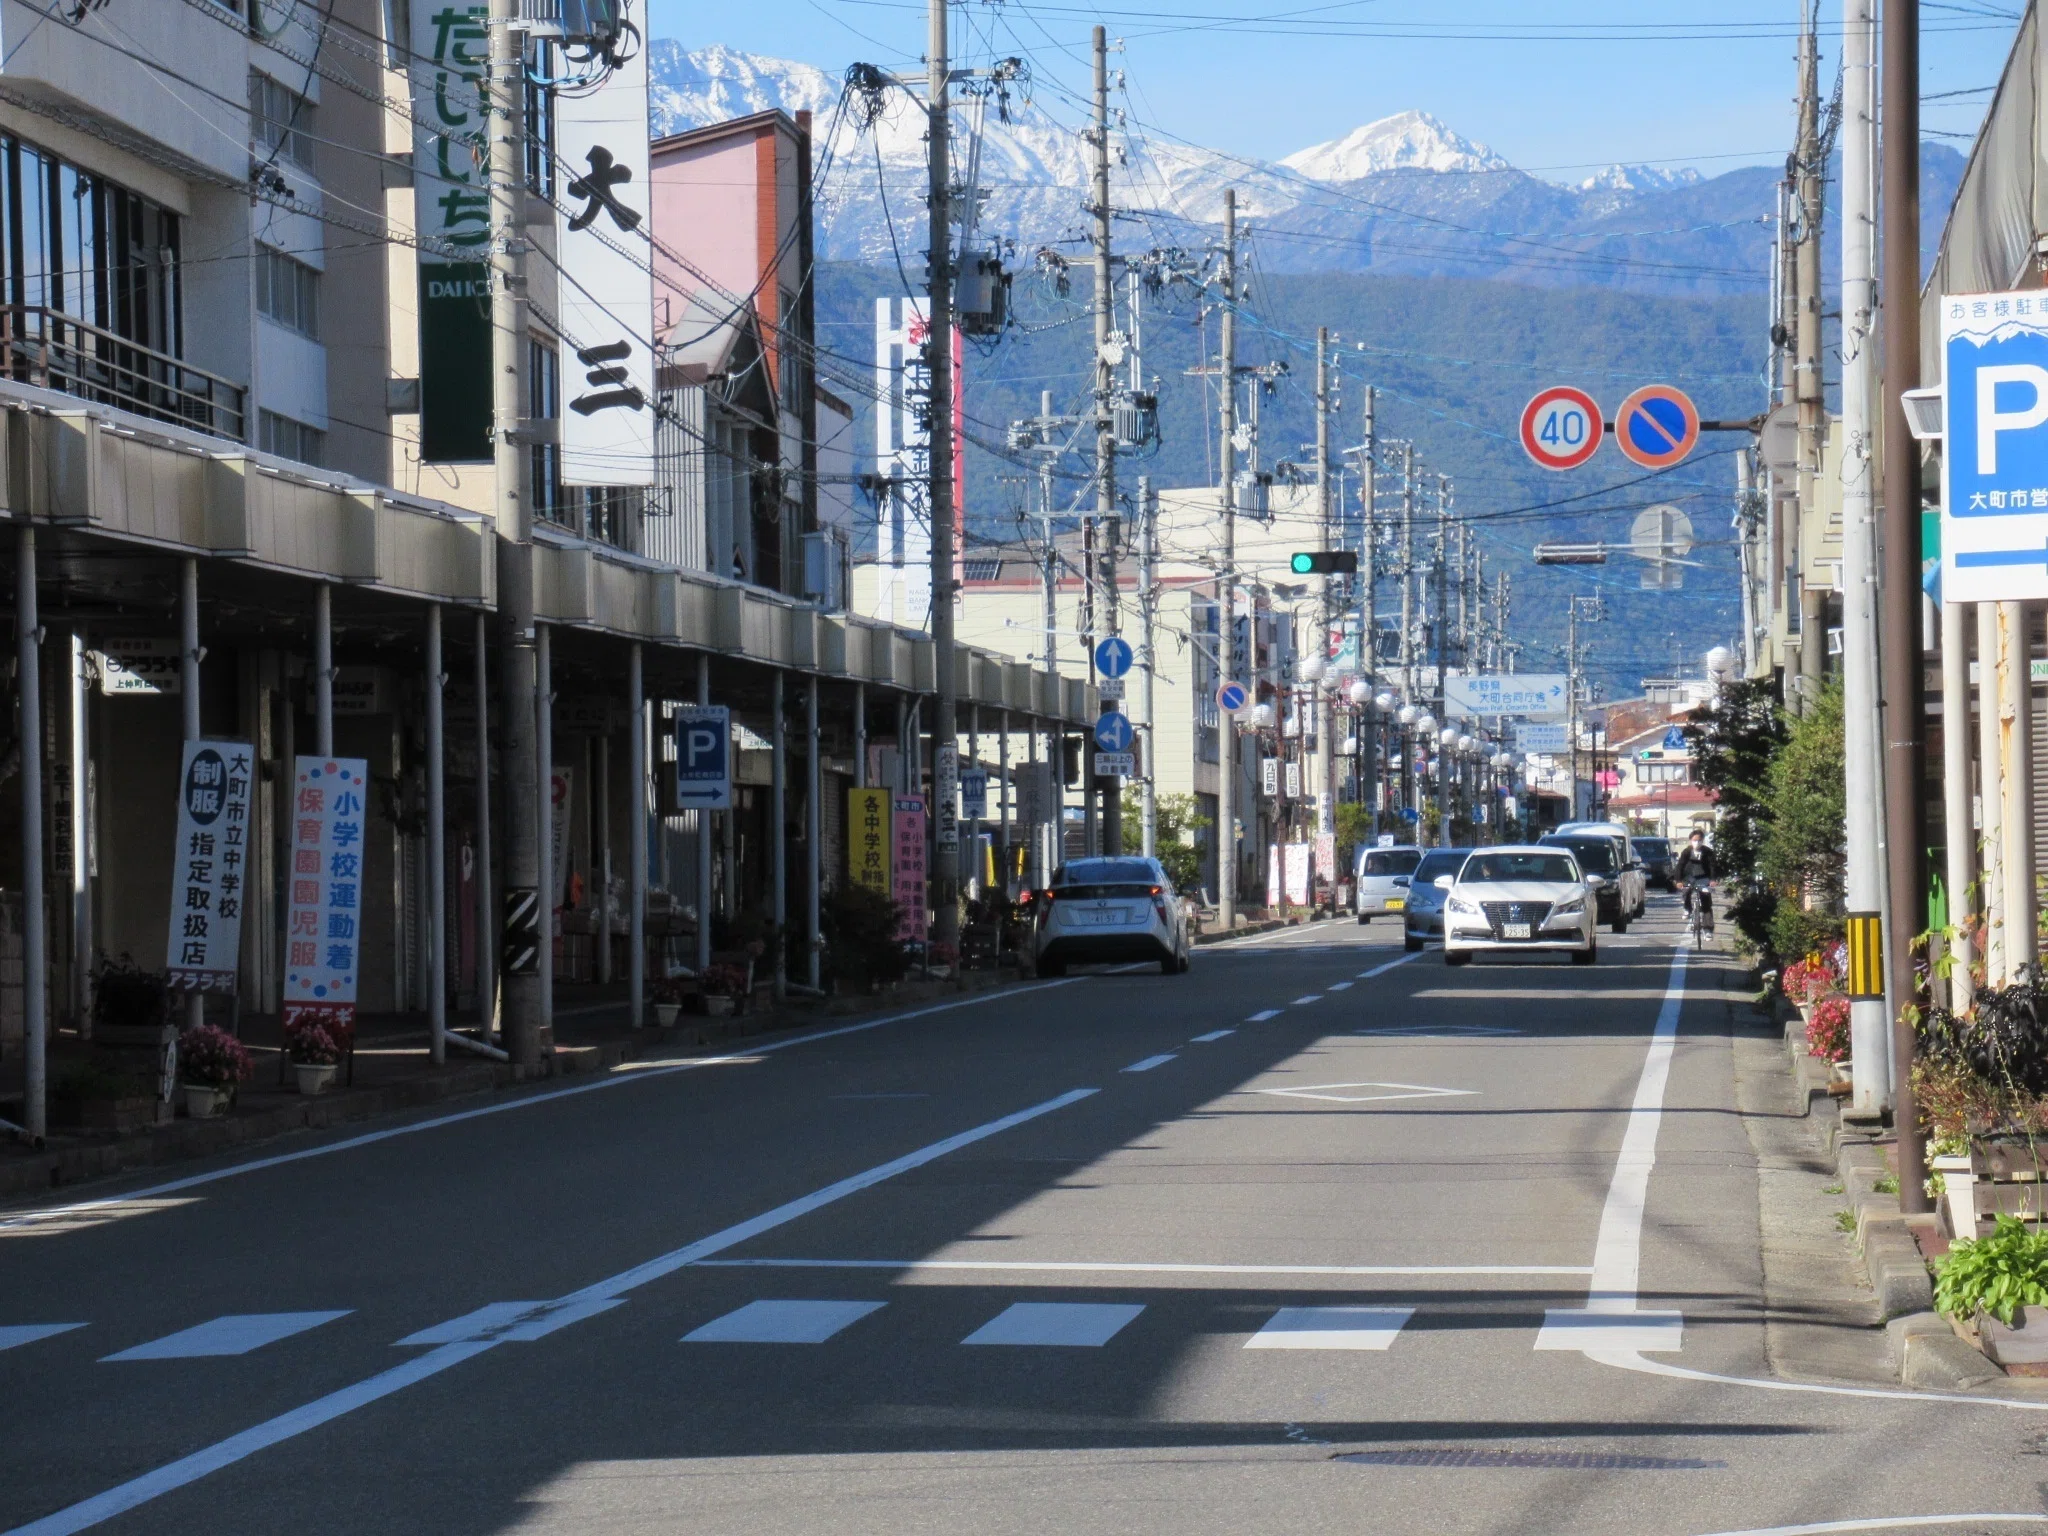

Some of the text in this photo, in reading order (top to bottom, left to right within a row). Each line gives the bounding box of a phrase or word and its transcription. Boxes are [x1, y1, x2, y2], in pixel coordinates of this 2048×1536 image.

[1541, 410, 1584, 446] 40
[1976, 363, 2048, 475] P
[1467, 680, 1501, 692] 長野県
[1479, 691, 1546, 704] 大町合同庁舎
[688, 729, 717, 767] P
[189, 758, 221, 817] 制服
[218, 752, 250, 920] 大町市立中学校
[864, 795, 881, 868] 各中学校
[181, 831, 216, 966] 指定取扱店
[290, 786, 325, 968] 保育園園児服
[327, 790, 361, 970] 小学校運動着
[166, 969, 235, 991] アララギ
